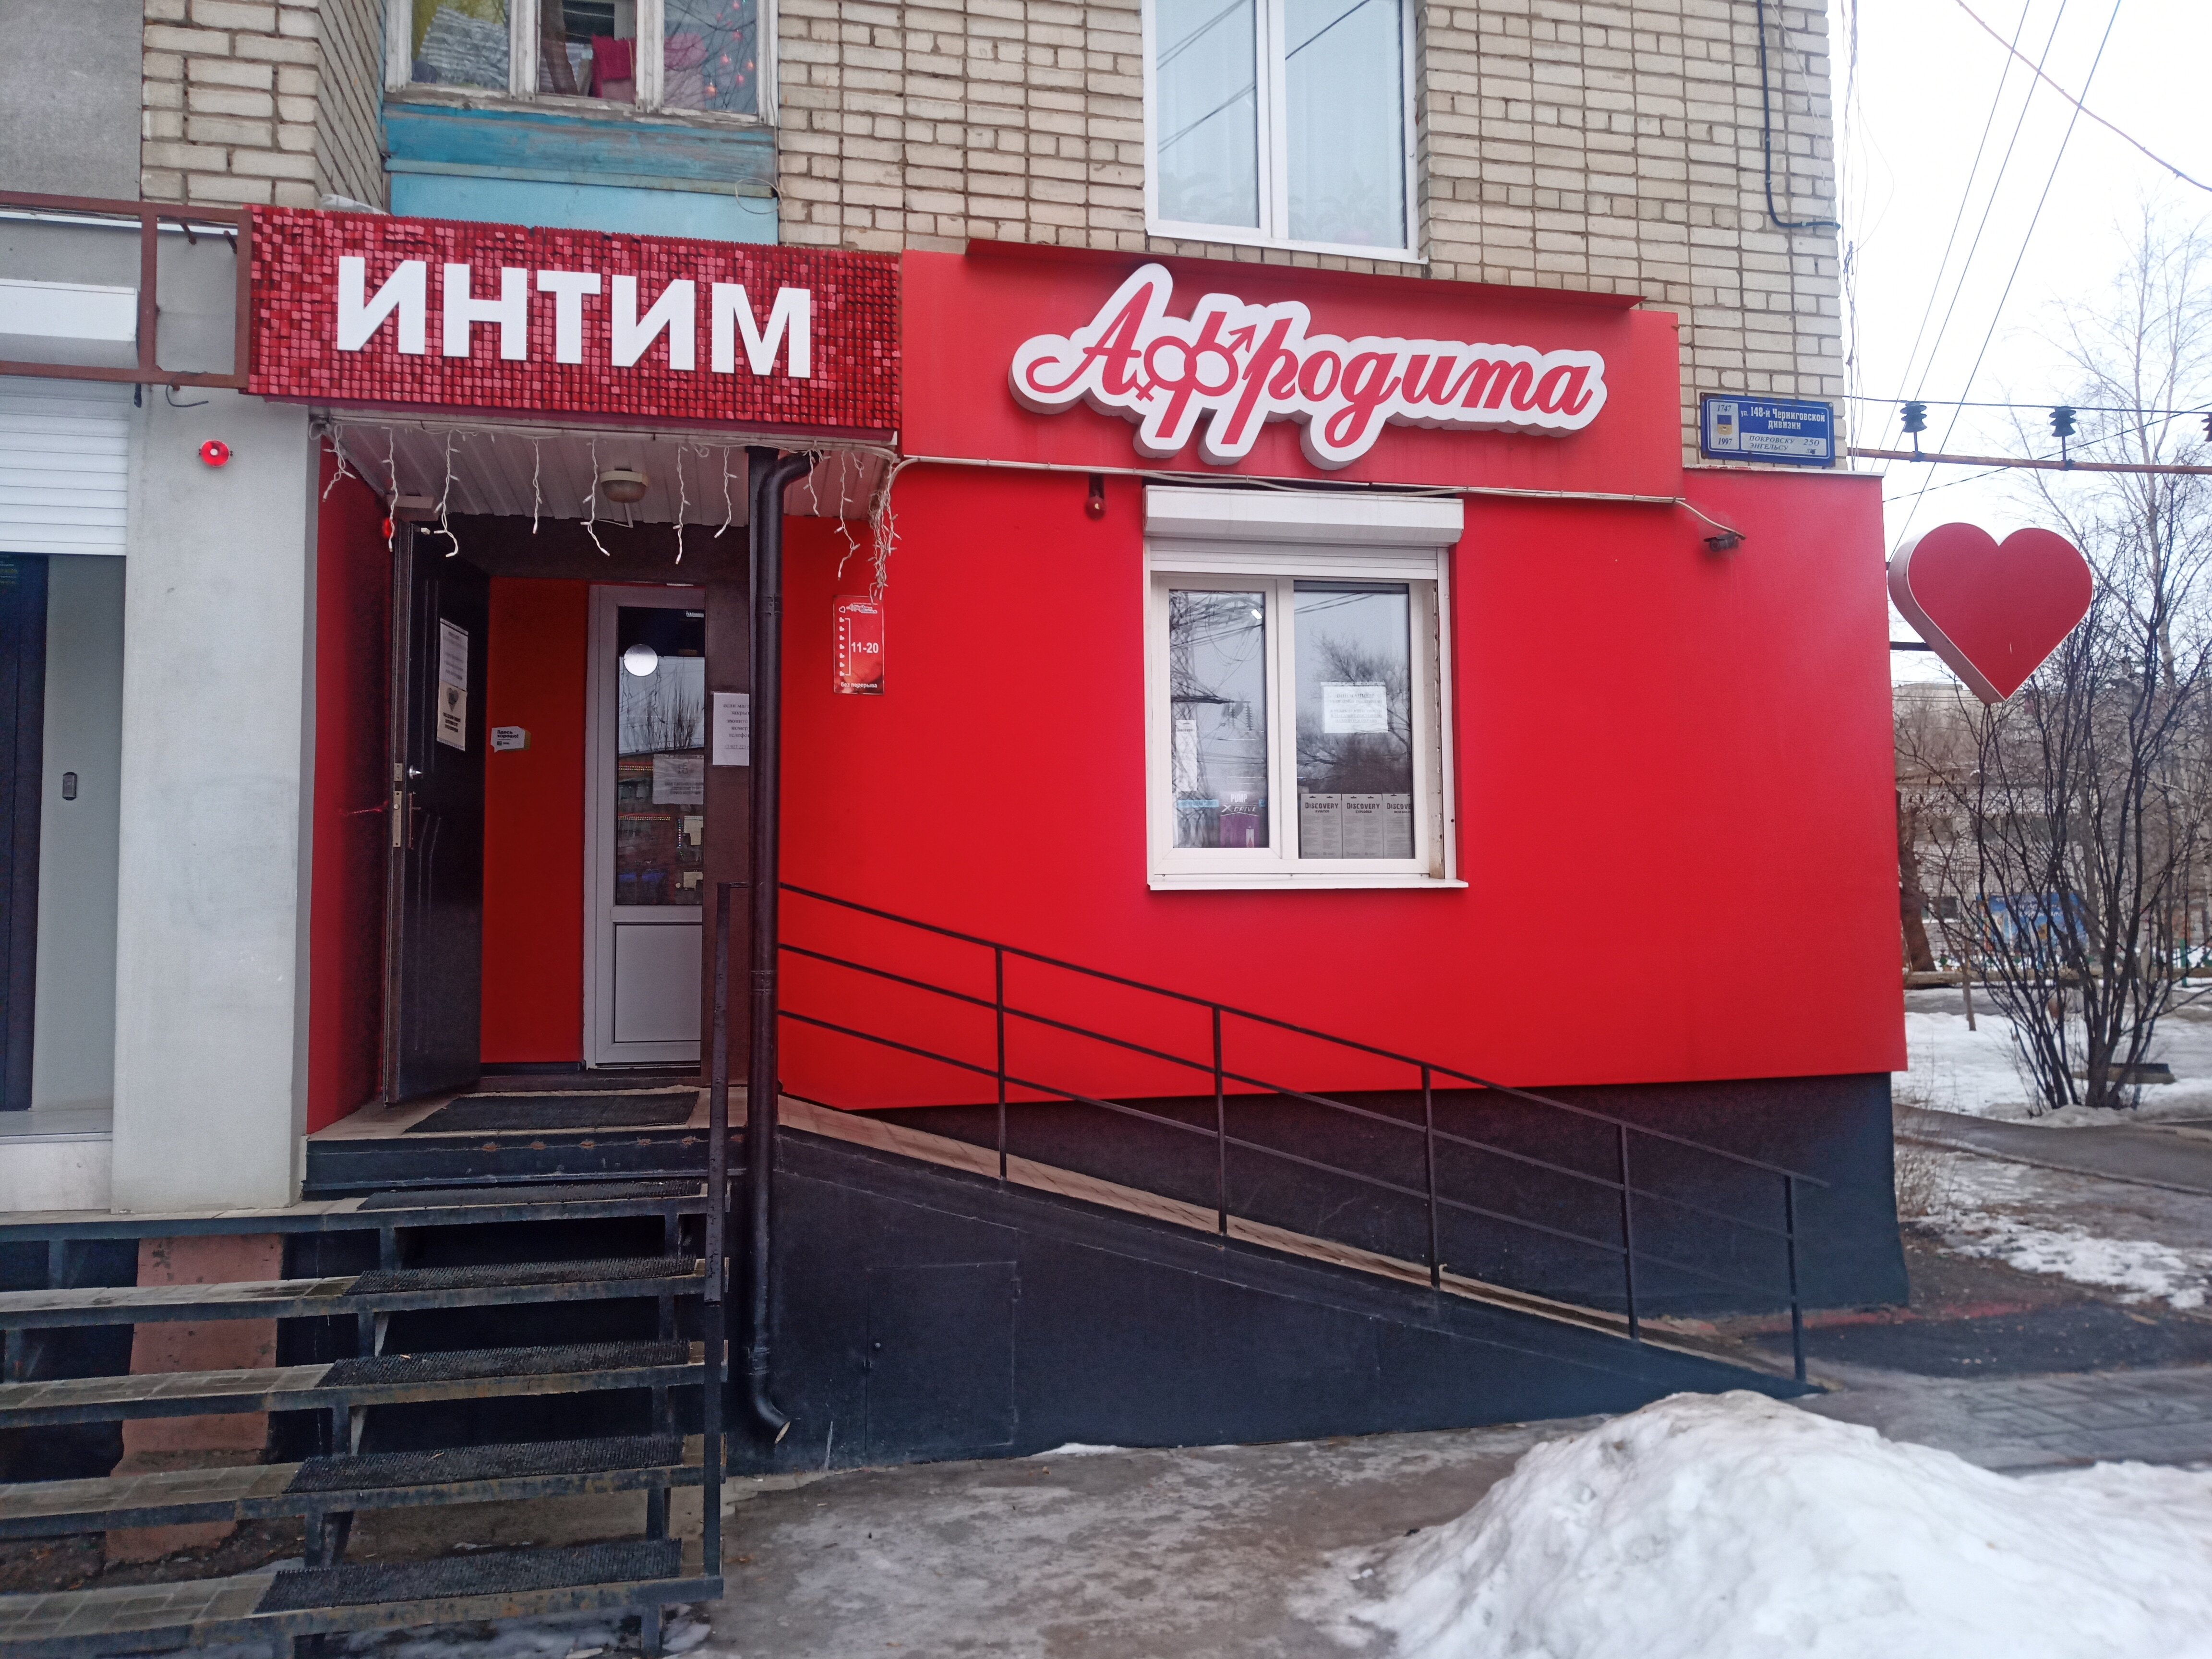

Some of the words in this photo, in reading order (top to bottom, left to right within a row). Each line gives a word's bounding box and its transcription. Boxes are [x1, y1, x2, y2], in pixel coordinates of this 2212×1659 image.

[337, 256, 811, 378] ИНТИМ
[1019, 275, 1596, 453] Афродита
[1751, 407, 1770, 418] 148-й
[1772, 409, 1825, 422] Черниговской
[1768, 421, 1801, 430] дивизии
[1749, 435, 1795, 444] ПОКРОВСКУ
[1750, 443, 1789, 451] ЭНГЕЛЬСУ
[851, 642, 879, 653] 11-20
[1231, 794, 1247, 802] PUMP
